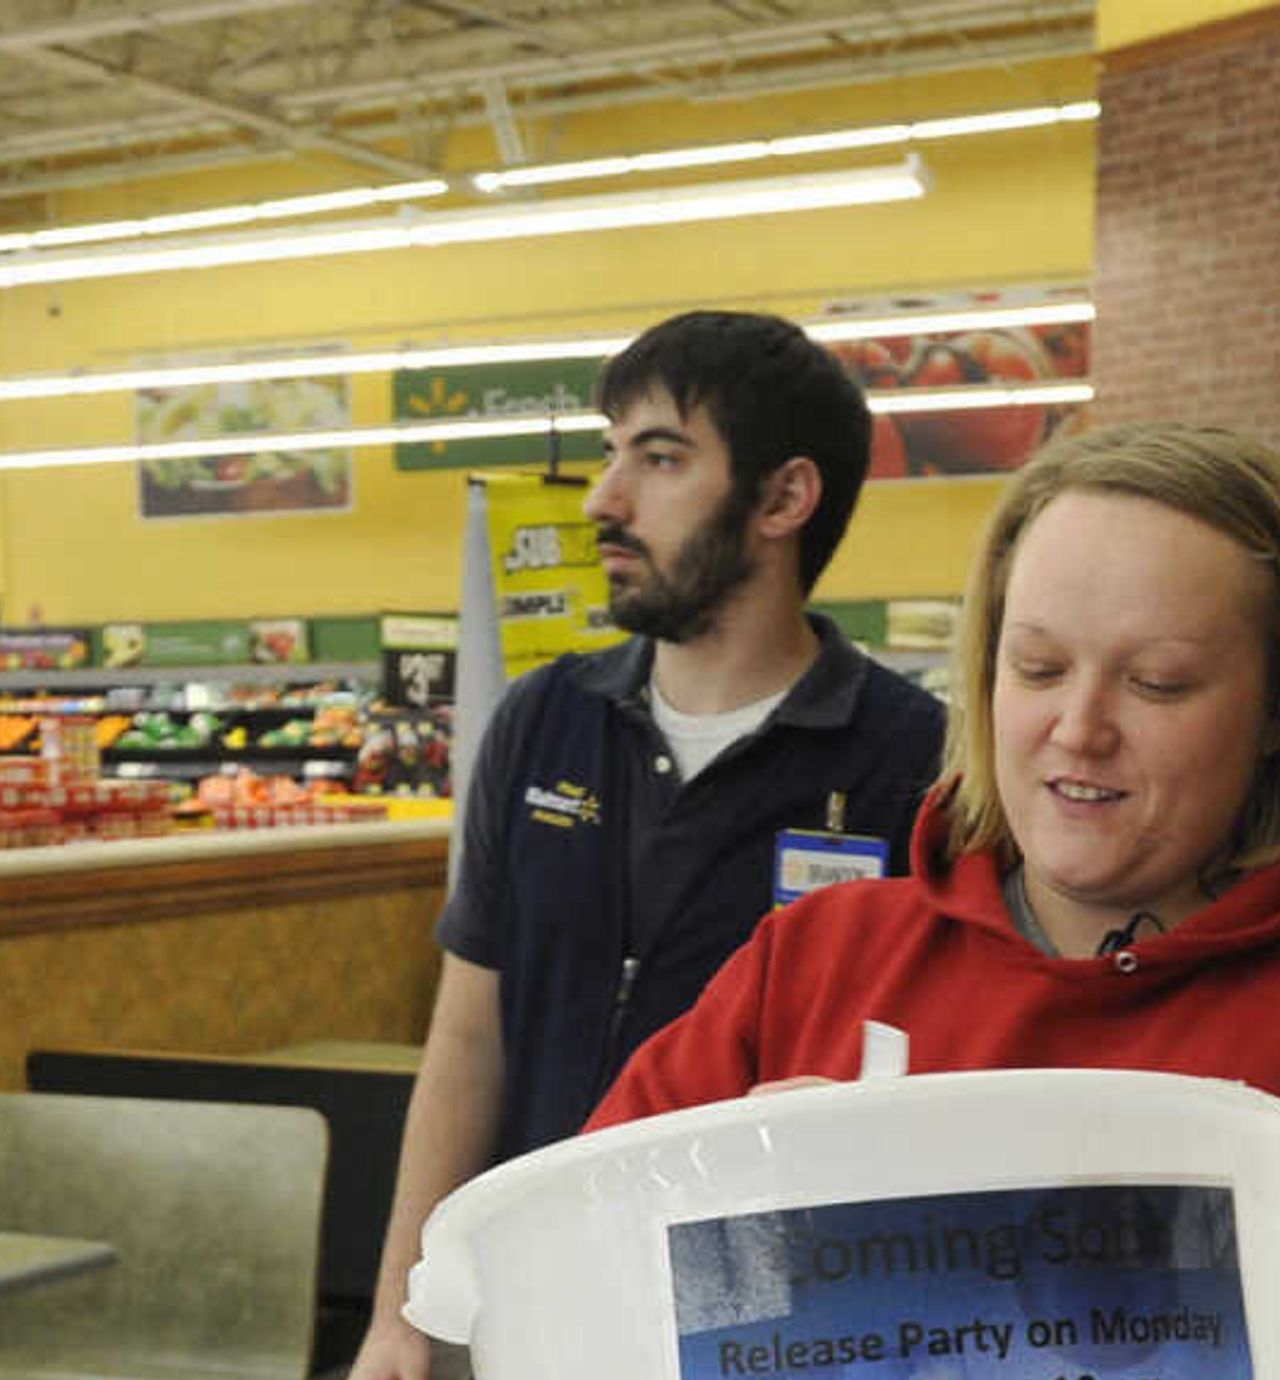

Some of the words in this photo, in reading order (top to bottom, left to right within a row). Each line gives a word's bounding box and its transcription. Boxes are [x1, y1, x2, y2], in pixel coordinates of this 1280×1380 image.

[720, 1334, 884, 1379] Release
[899, 1314, 1013, 1359] Party
[1026, 1317, 1076, 1349] on
[1091, 1304, 1222, 1348] Monday
